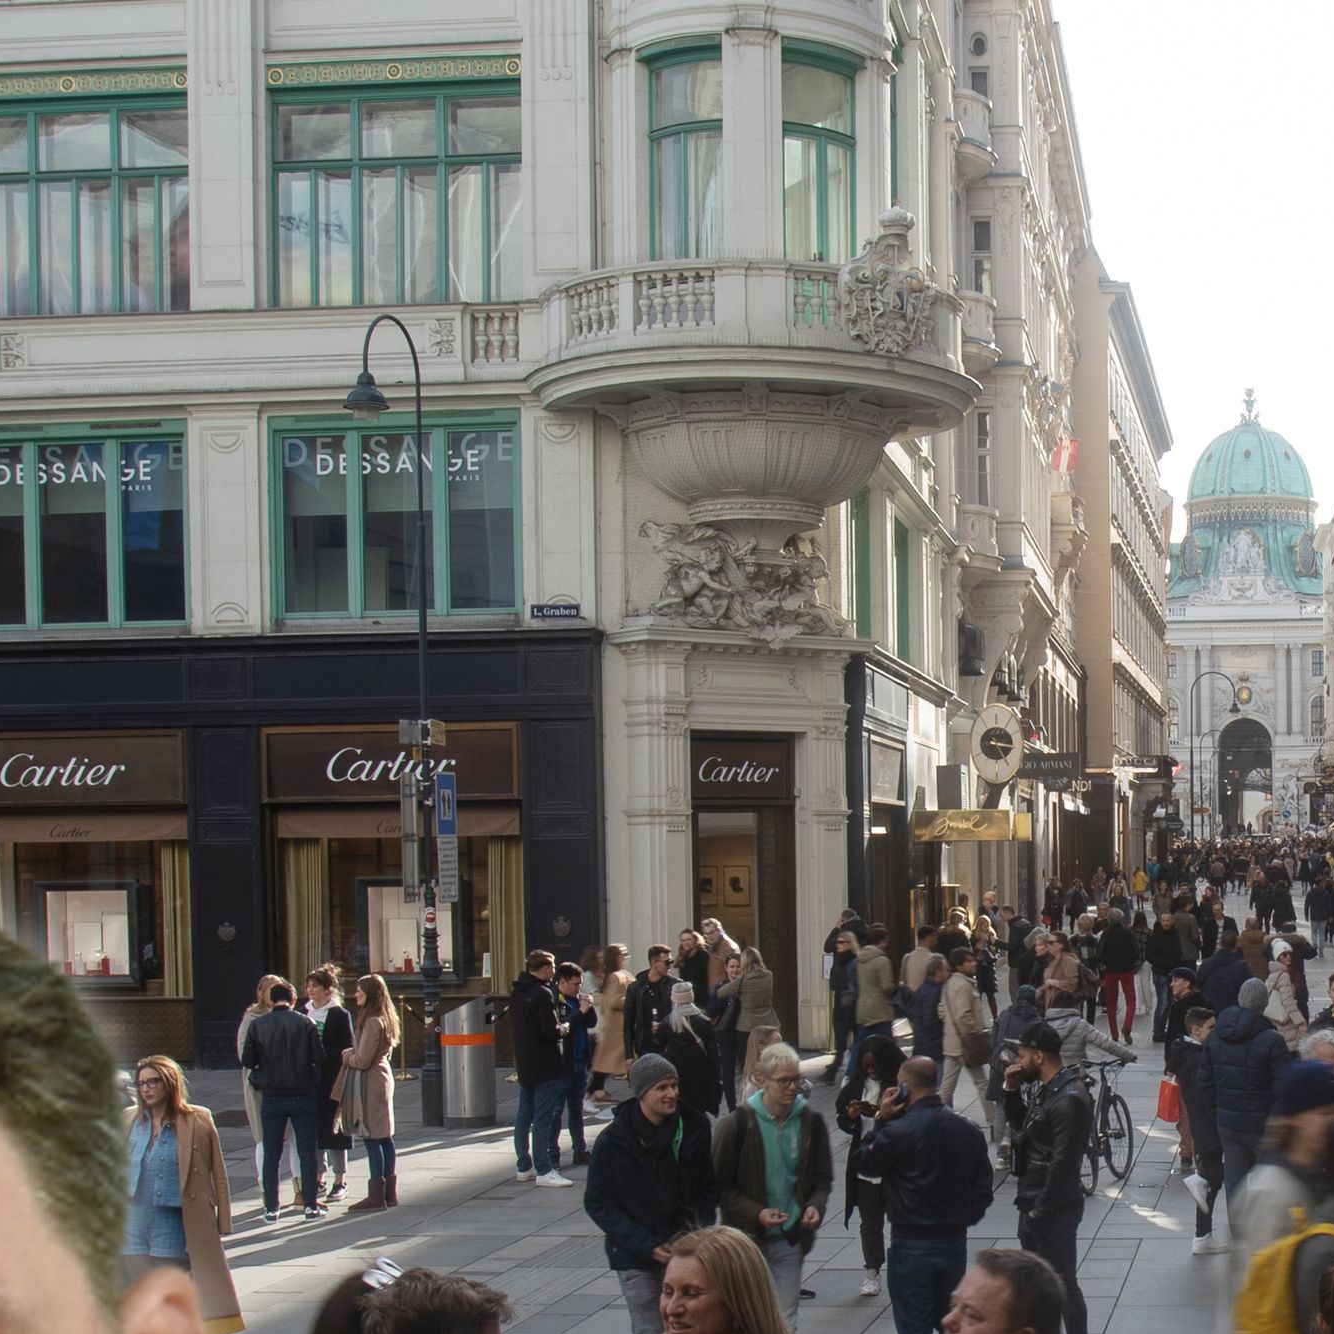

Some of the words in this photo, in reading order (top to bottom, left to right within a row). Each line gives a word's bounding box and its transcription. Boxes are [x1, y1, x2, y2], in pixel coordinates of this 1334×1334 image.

[448, 474, 480, 482] PARIS
[121, 484, 153, 492] PARIS
[543, 607, 577, 616] Graben
[699, 756, 779, 782] Cartier
[1040, 760, 1072, 769] ARMANI
[0, 753, 126, 787] Cartier
[50, 825, 93, 838] Cartier
